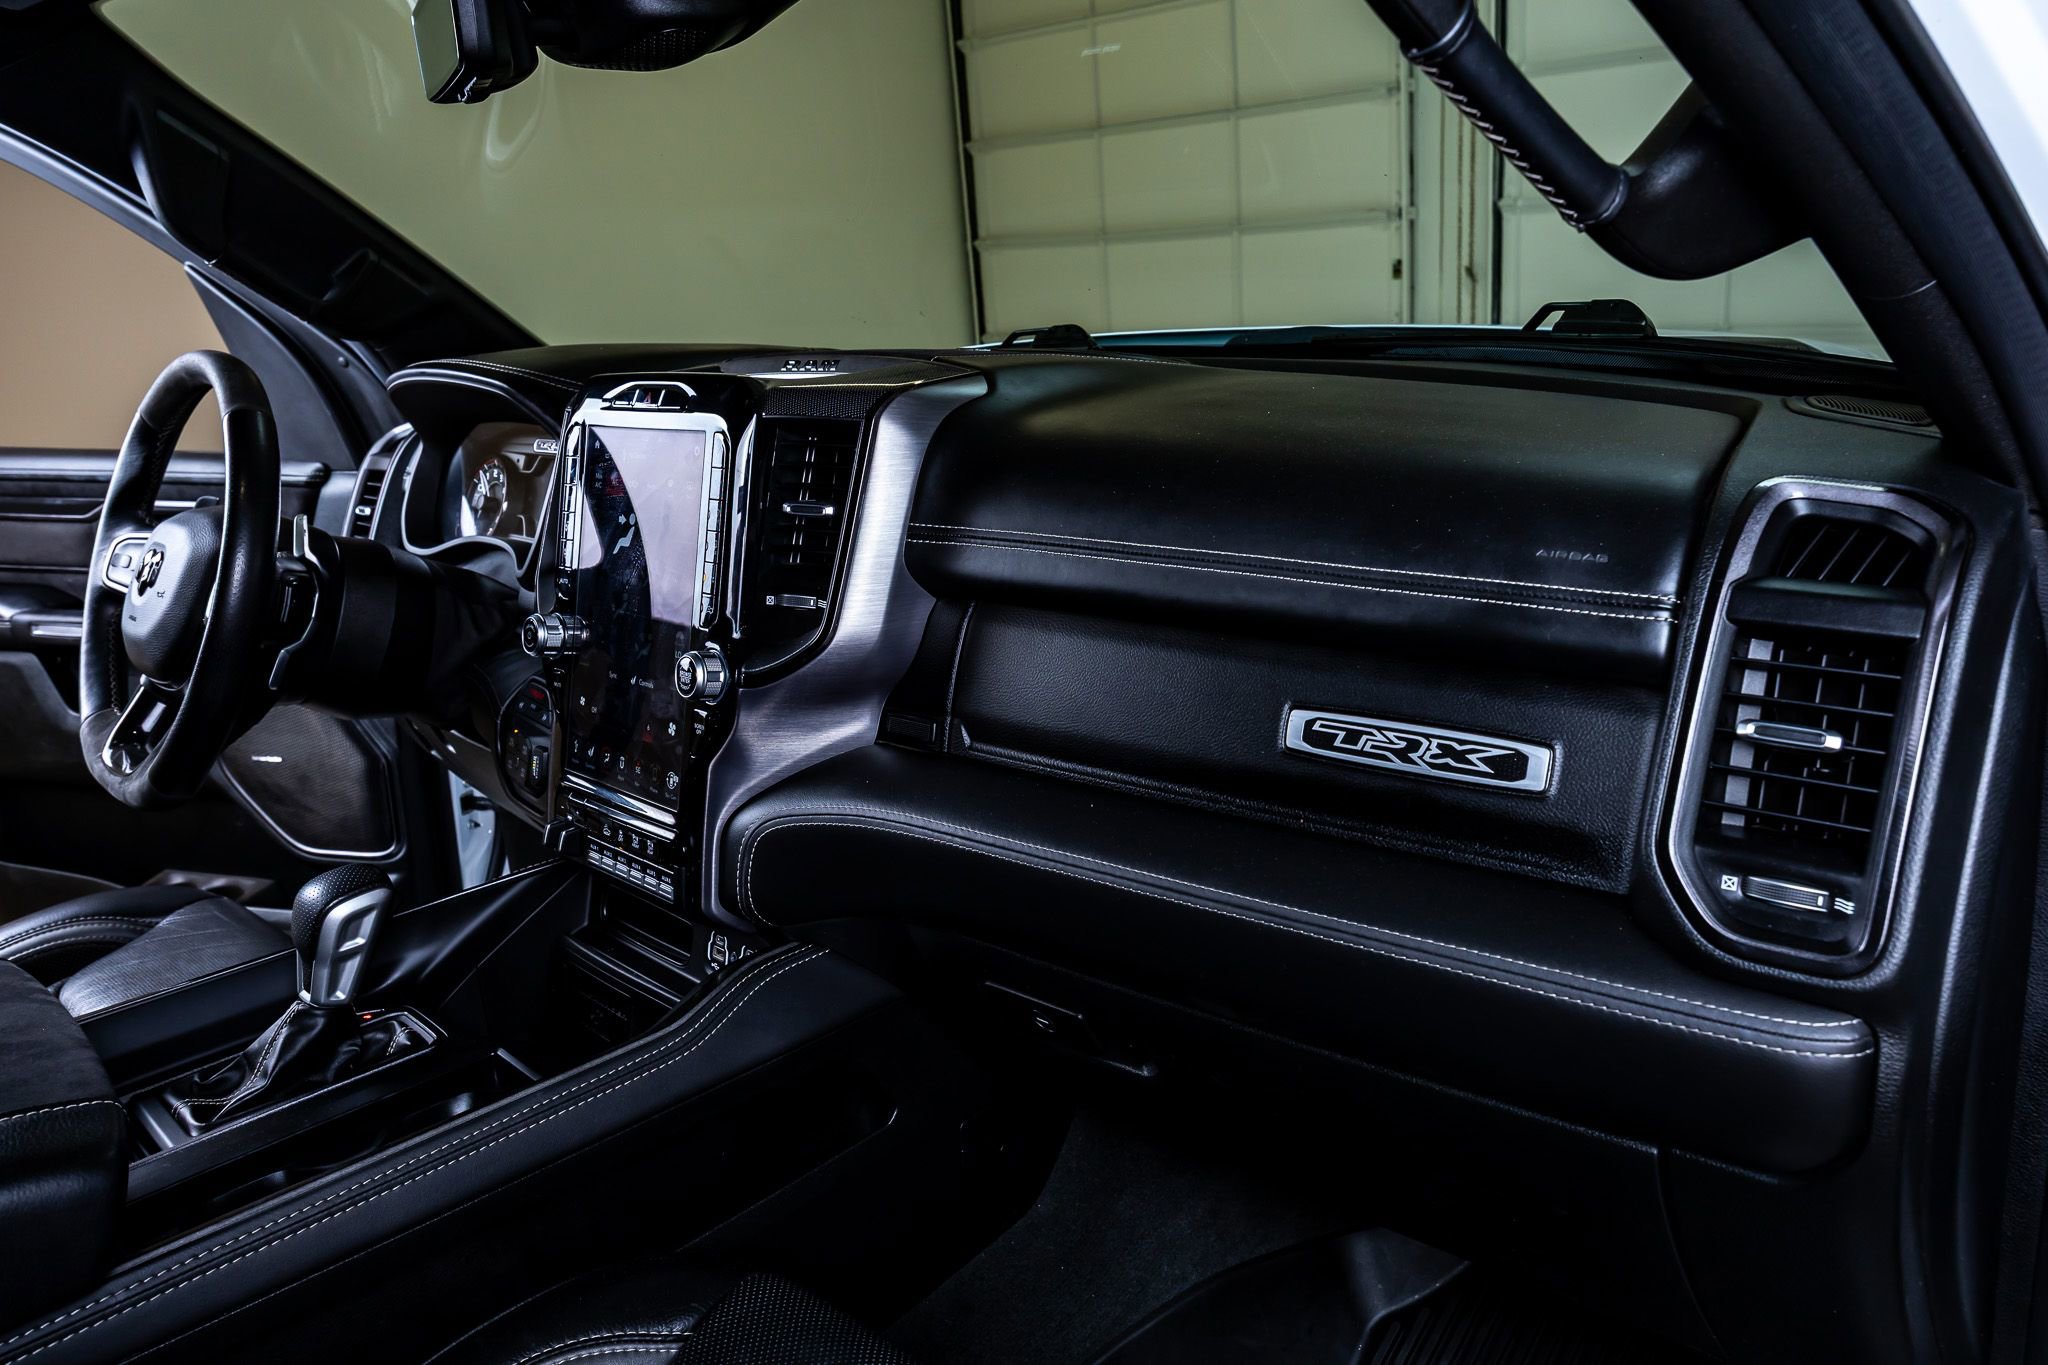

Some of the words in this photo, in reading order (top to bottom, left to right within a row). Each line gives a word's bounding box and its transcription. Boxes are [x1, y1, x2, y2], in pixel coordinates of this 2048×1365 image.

[780, 359, 841, 372] RAM
[1535, 548, 1609, 563] AIRBAG
[1311, 719, 1517, 774] TRX
